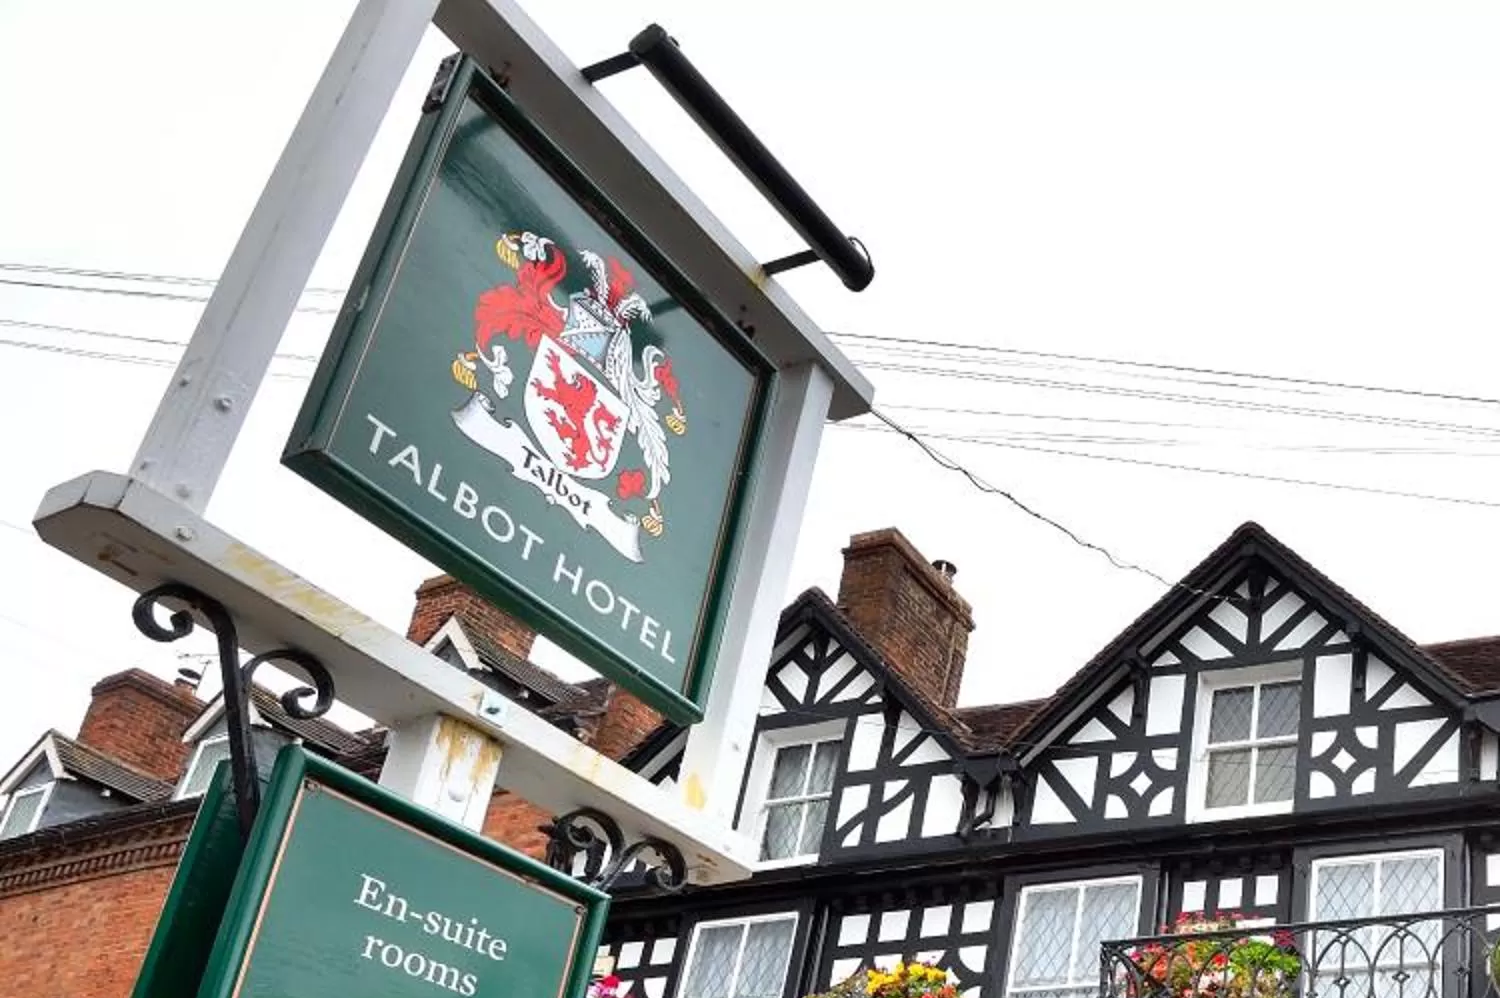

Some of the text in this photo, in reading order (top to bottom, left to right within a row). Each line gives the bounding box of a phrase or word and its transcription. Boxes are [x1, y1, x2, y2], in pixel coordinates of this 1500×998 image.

[521, 445, 592, 517] Talbot
[366, 414, 677, 664] TALBOT HOTEL
[354, 873, 508, 961] En-suite
[361, 933, 480, 997] rooms
